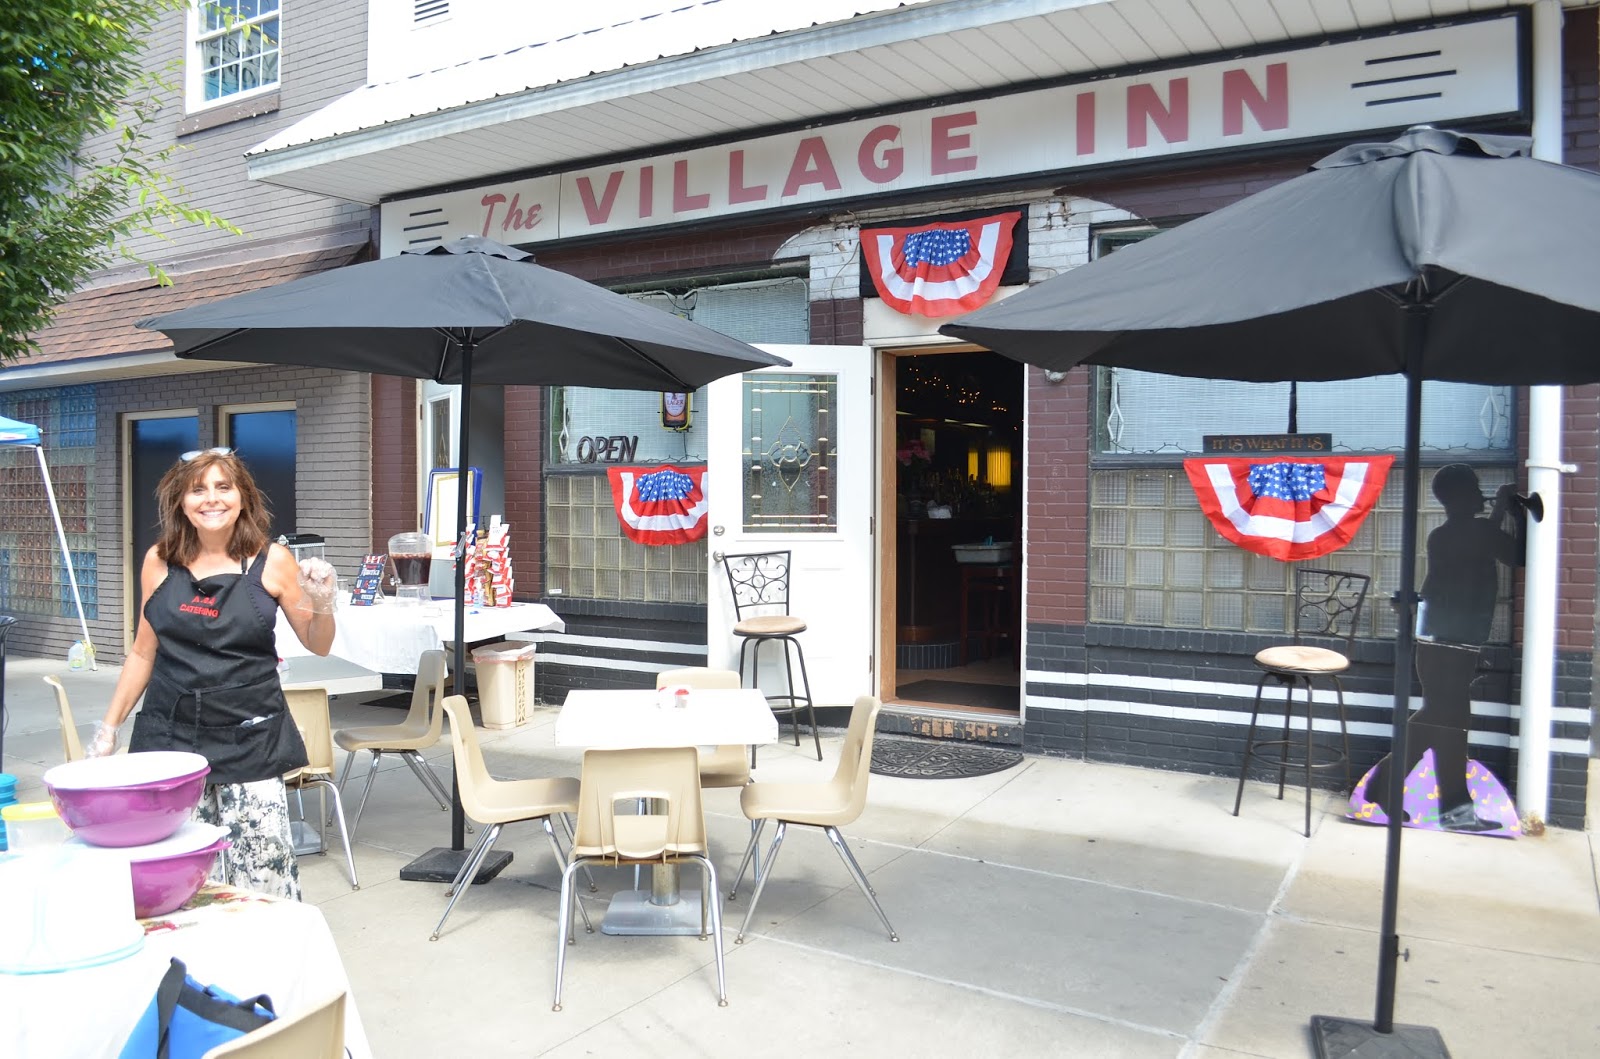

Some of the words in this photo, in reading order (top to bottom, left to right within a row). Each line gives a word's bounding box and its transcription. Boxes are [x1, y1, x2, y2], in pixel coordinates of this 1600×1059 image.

[481, 193, 542, 237] The
[576, 111, 978, 226] VILLAGE
[1076, 62, 1289, 156] INN
[576, 435, 639, 463] OPEN
[1212, 439, 1226, 450] IT
[1228, 438, 1243, 452] IS
[1245, 438, 1288, 452] WHAT
[1291, 437, 1304, 449] IT
[179, 603, 219, 618] CATERING
